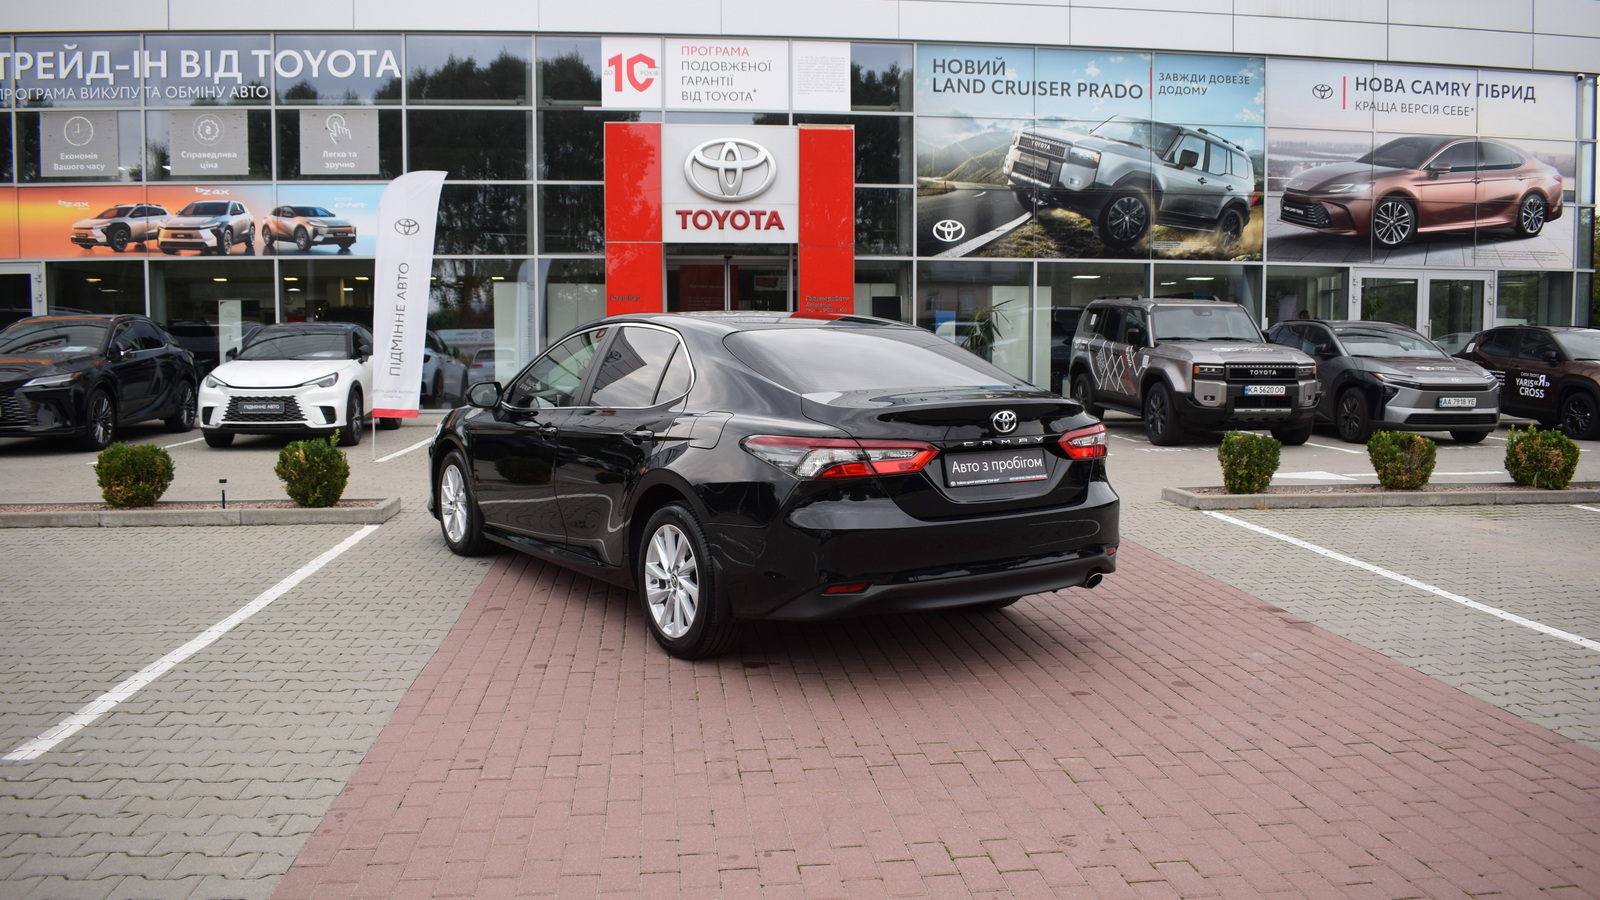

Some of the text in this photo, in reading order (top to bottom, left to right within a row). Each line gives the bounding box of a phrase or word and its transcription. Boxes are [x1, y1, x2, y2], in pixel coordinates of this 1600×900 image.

[681, 46, 750, 57] ПРОГРАМА
[181, 50, 242, 84] ВІД
[251, 49, 402, 78] TOYOTA
[681, 60, 772, 73] ПОДОВЖЕНОЇ
[933, 56, 1005, 76] НОВИЙ
[681, 74, 734, 86] ГАРАНТІЇ
[1159, 72, 1250, 85] ЗАВЖДИ ДОВЕЗЕ
[81, 86, 140, 99] ВИКУПУ
[144, 86, 161, 99] ТА
[165, 86, 226, 99] ОБМІНУ
[229, 85, 269, 99] АВТО
[933, 77, 1143, 99] LAND CRUISER PRADO
[1158, 85, 1208, 96] ДОДОМУ
[1355, 76, 1536, 104] НОВА CAMRY ГІБРИД
[681, 91, 702, 102] ВІД
[1355, 100, 1397, 114] КРАЩА
[1401, 103, 1439, 115] ВЕРСІЯ
[60, 152, 98, 160] Економія
[181, 150, 238, 160] Справедлива
[322, 150, 347, 158] Легко
[53, 163, 85, 171] Вашого
[200, 160, 219, 169] ціна
[676, 209, 785, 230] TOYOTA
[397, 262, 410, 301] АВТО
[389, 304, 406, 377] ПІДМІННЕ
[1515, 377, 1534, 388] YARIS
[1519, 386, 1545, 399] CROSS
[963, 436, 1043, 447] CAMRY
[952, 456, 1043, 473] Авто з пробігом
